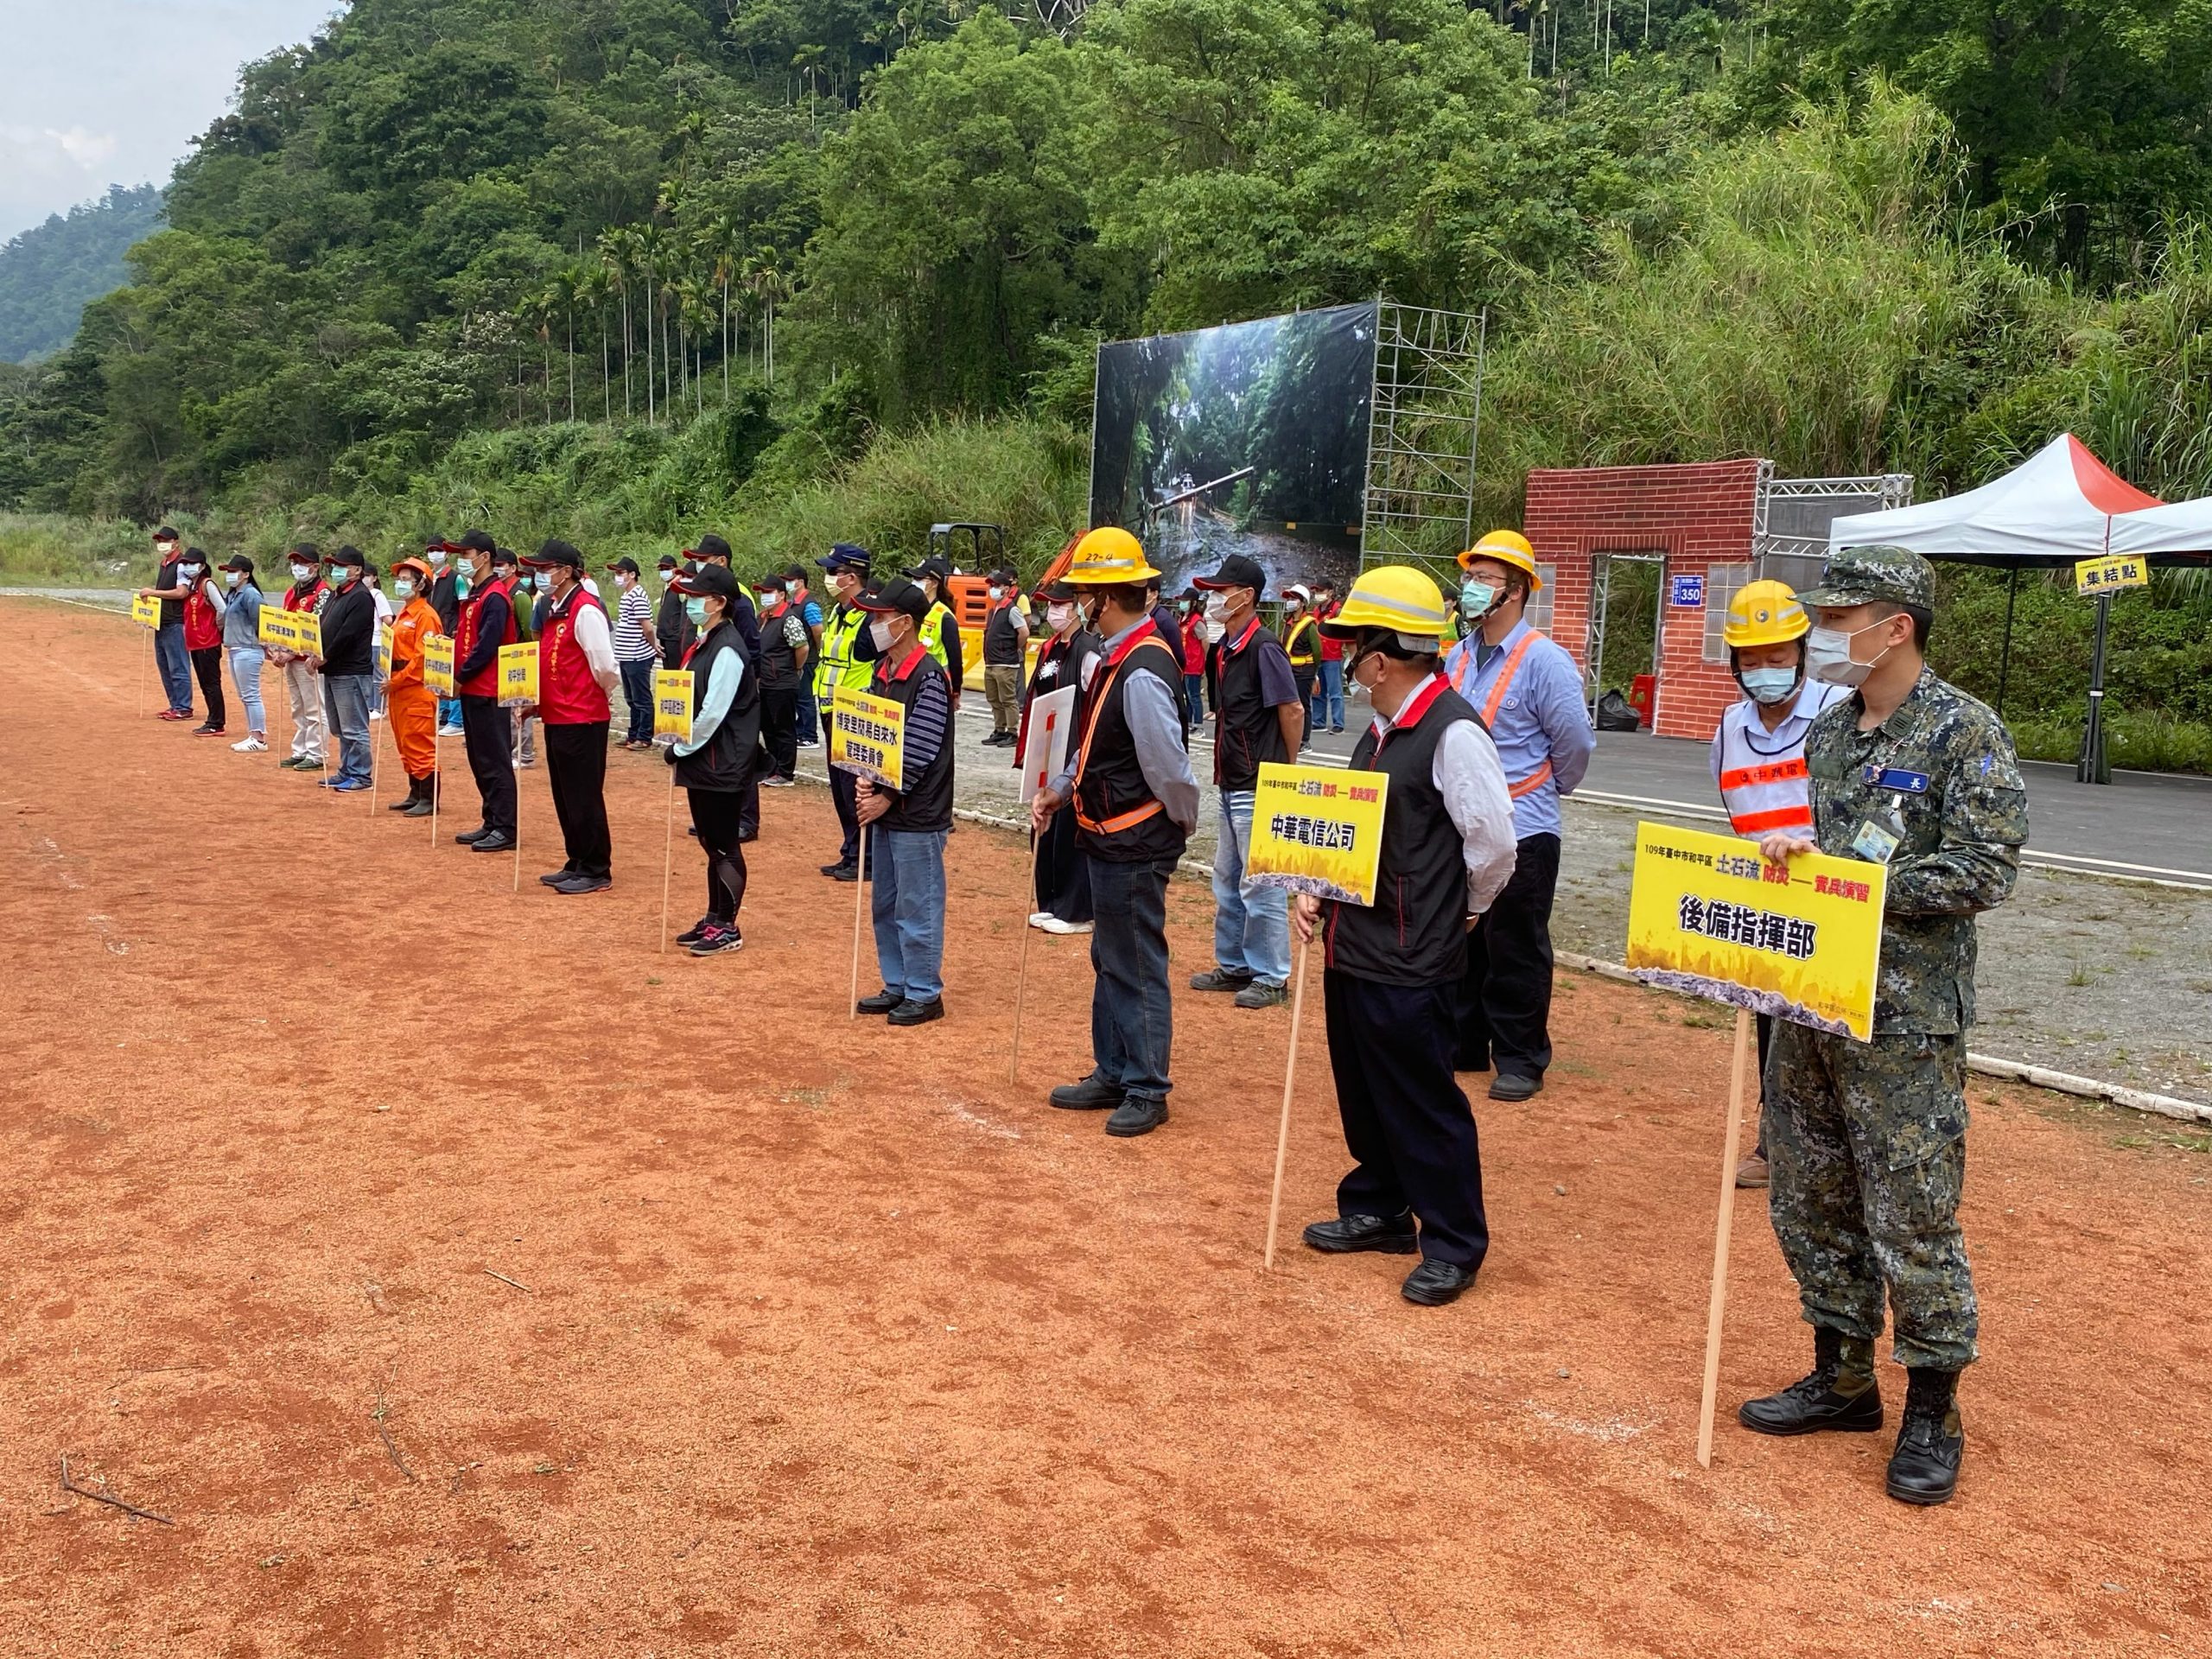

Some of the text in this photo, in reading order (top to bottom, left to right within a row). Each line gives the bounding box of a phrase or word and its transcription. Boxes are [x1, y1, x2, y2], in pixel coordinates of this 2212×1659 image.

[2086, 563, 2137, 586] 集結點
[1681, 588, 1700, 601] 350
[846, 740, 884, 768] 管理委員會
[1298, 779, 1322, 797] 土石流
[1271, 814, 1355, 852] 中華電信公司
[1644, 843, 1713, 867] 109年臺中市和平區
[1715, 853, 1761, 880] 土石流
[1679, 893, 1817, 959] 後備指揮部
